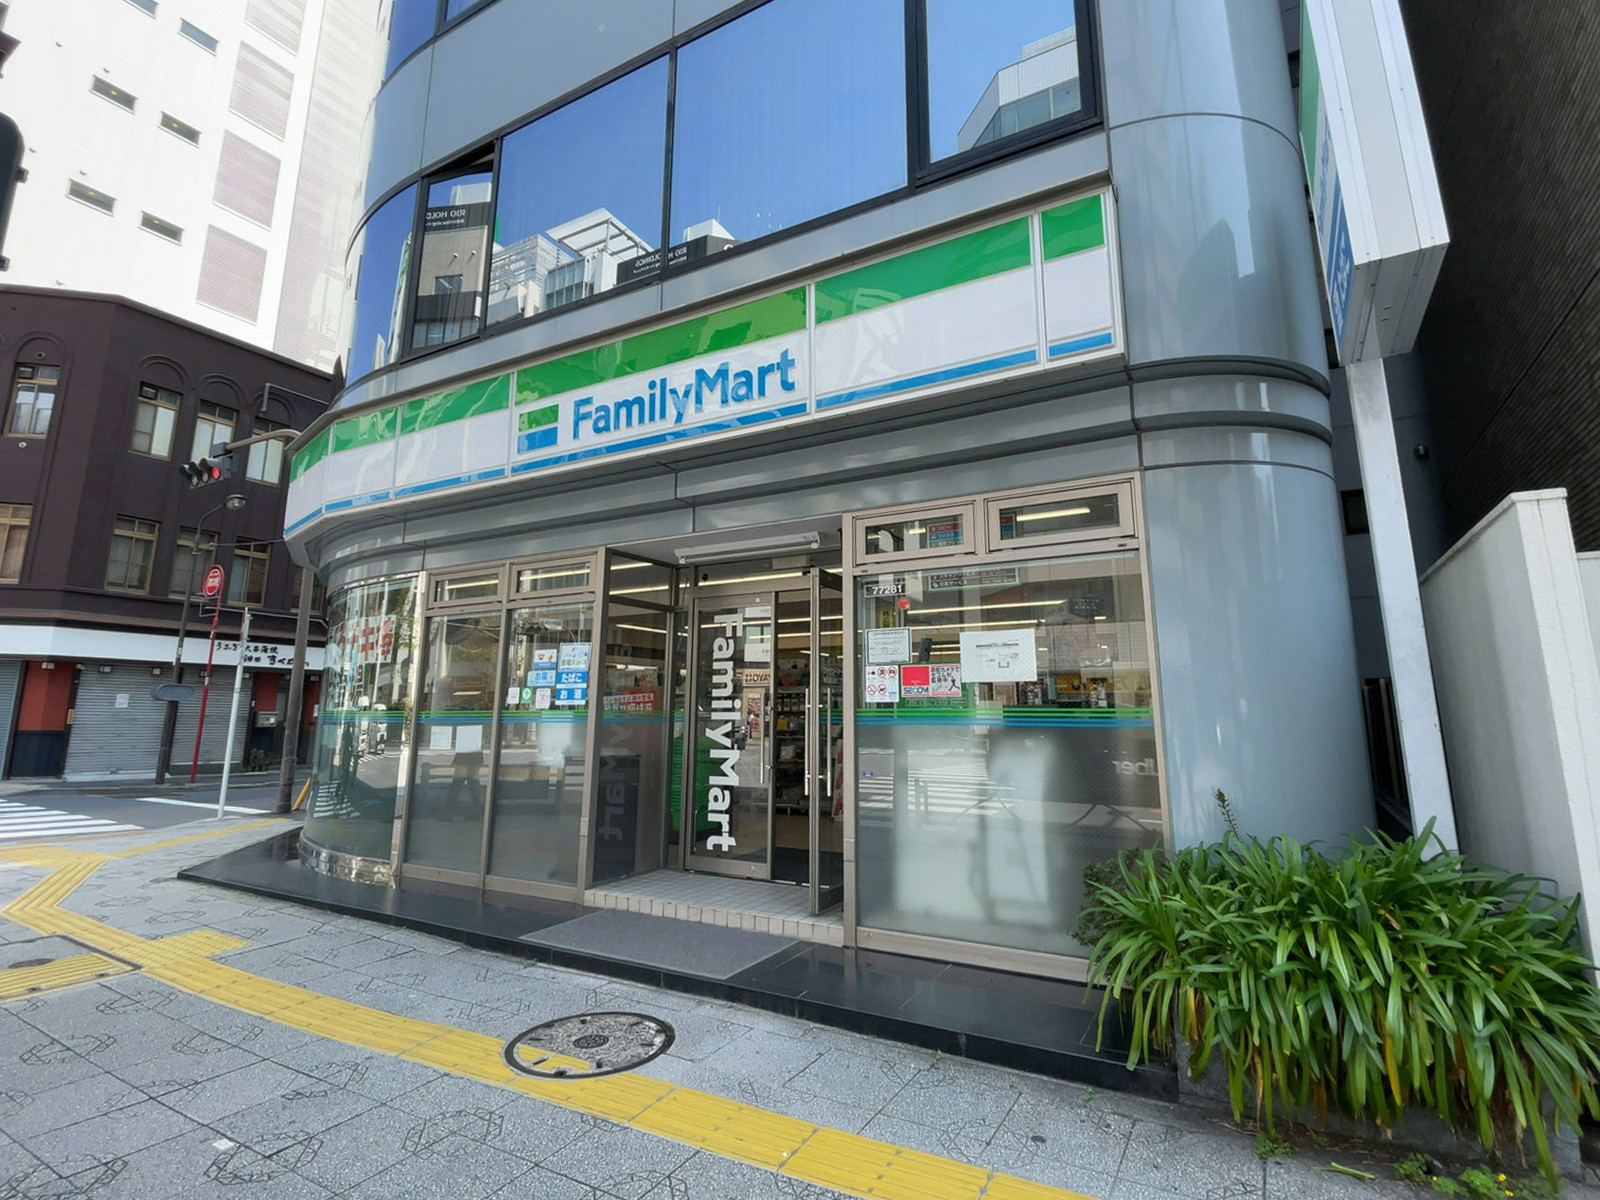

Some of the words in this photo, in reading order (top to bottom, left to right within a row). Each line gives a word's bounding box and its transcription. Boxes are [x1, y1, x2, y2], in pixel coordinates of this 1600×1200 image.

[572, 348, 796, 440] FamilyMart
[872, 584, 902, 595] 77281
[561, 673, 582, 683] たばこ
[903, 686, 929, 695] SECOM
[705, 613, 743, 852] FamilyMart
